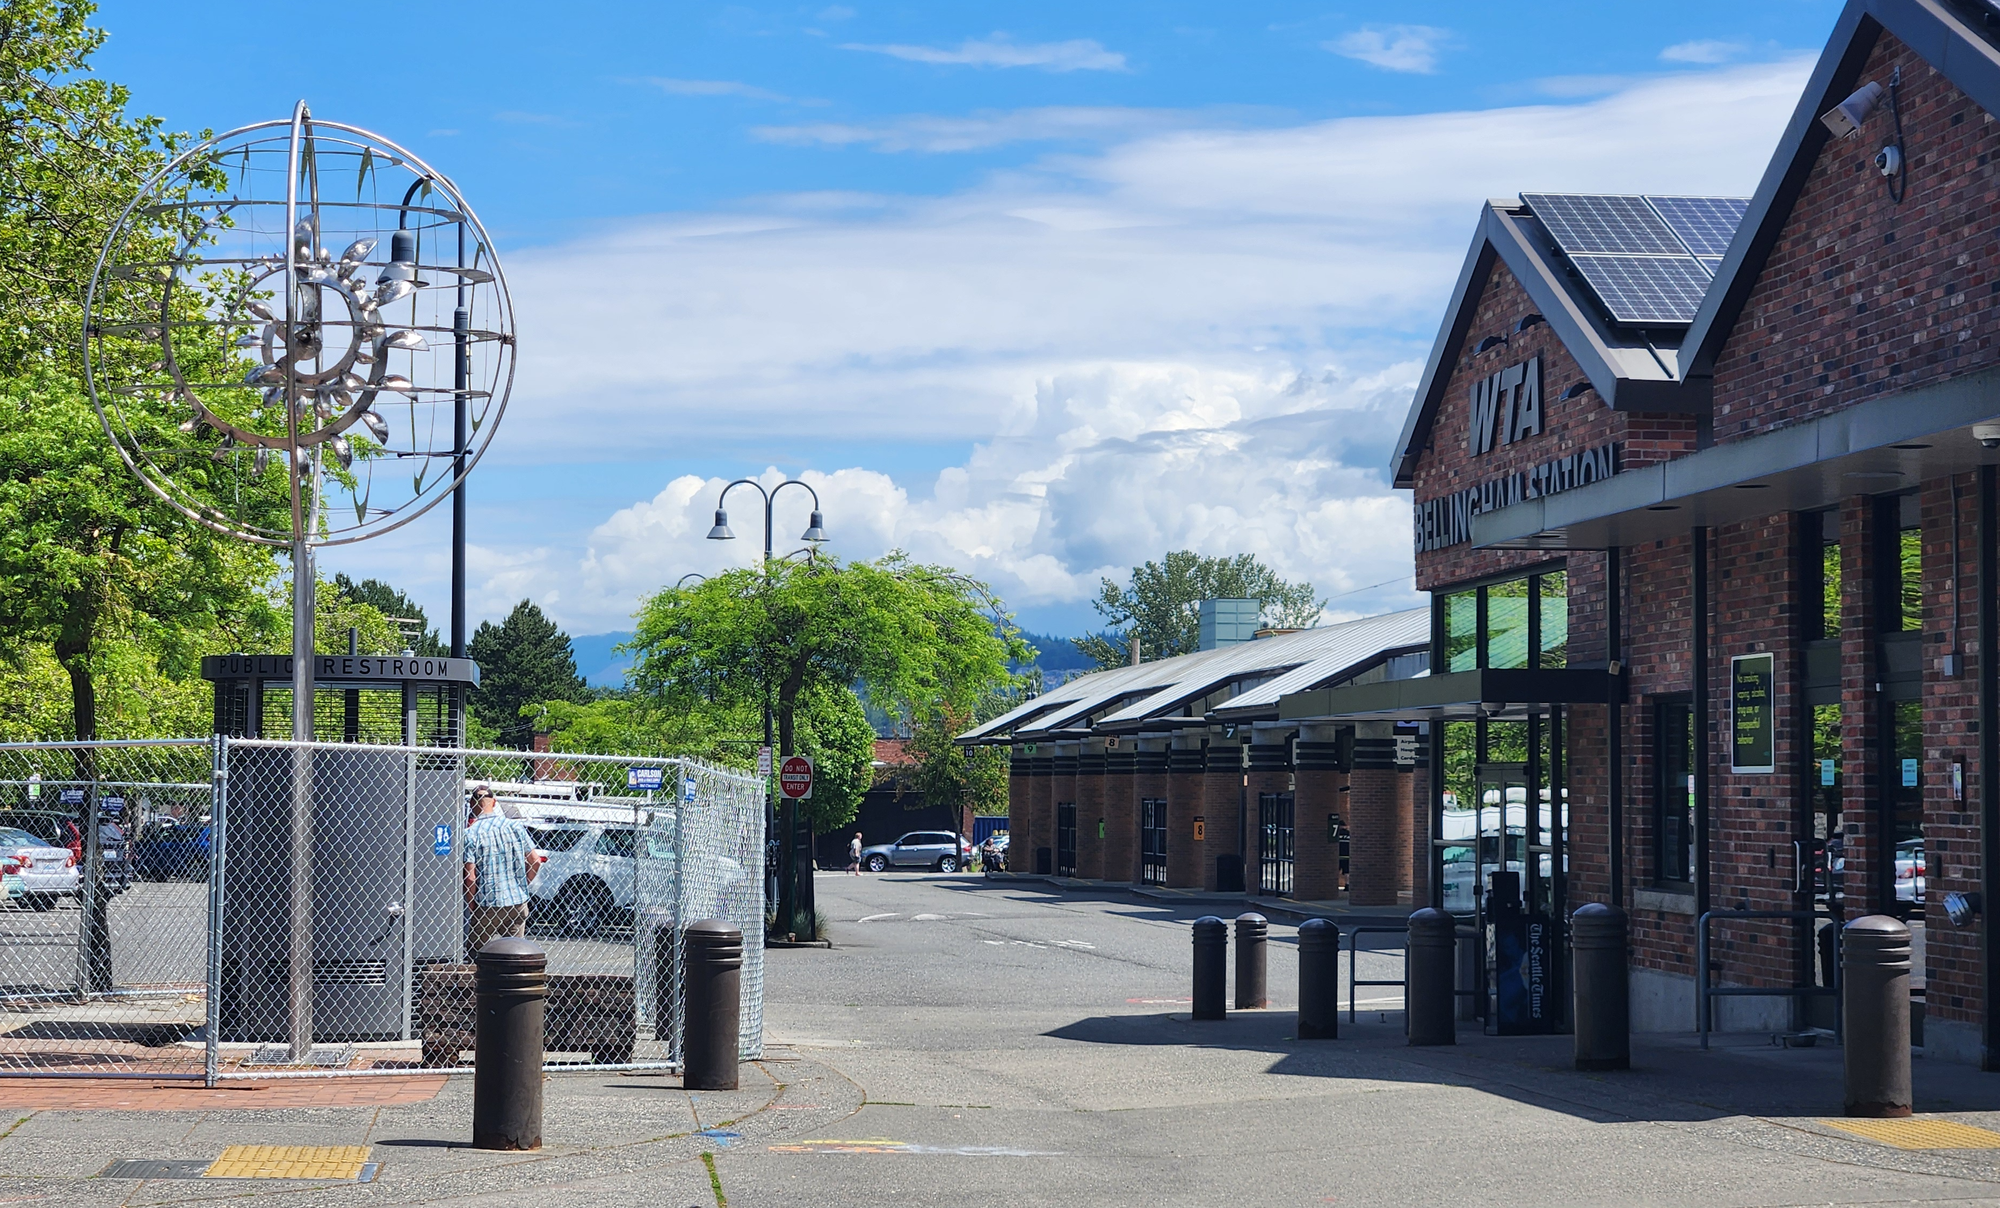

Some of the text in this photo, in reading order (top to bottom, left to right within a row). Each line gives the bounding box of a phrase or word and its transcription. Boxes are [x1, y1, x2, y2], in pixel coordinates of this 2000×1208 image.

[1469, 356, 1542, 458] WTA
[1414, 442, 1617, 554] BELLINGHAM STATION
[218, 657, 449, 677] PUBLIC RESTROOM
[1226, 728, 1234, 738] 7
[1108, 739, 1115, 747] 8
[1027, 745, 1034, 753] 9
[637, 769, 662, 778] CARLSON
[1198, 825, 1203, 836] 8
[1332, 825, 1339, 837] 7
[1529, 923, 1544, 1019] The Seattle Times
